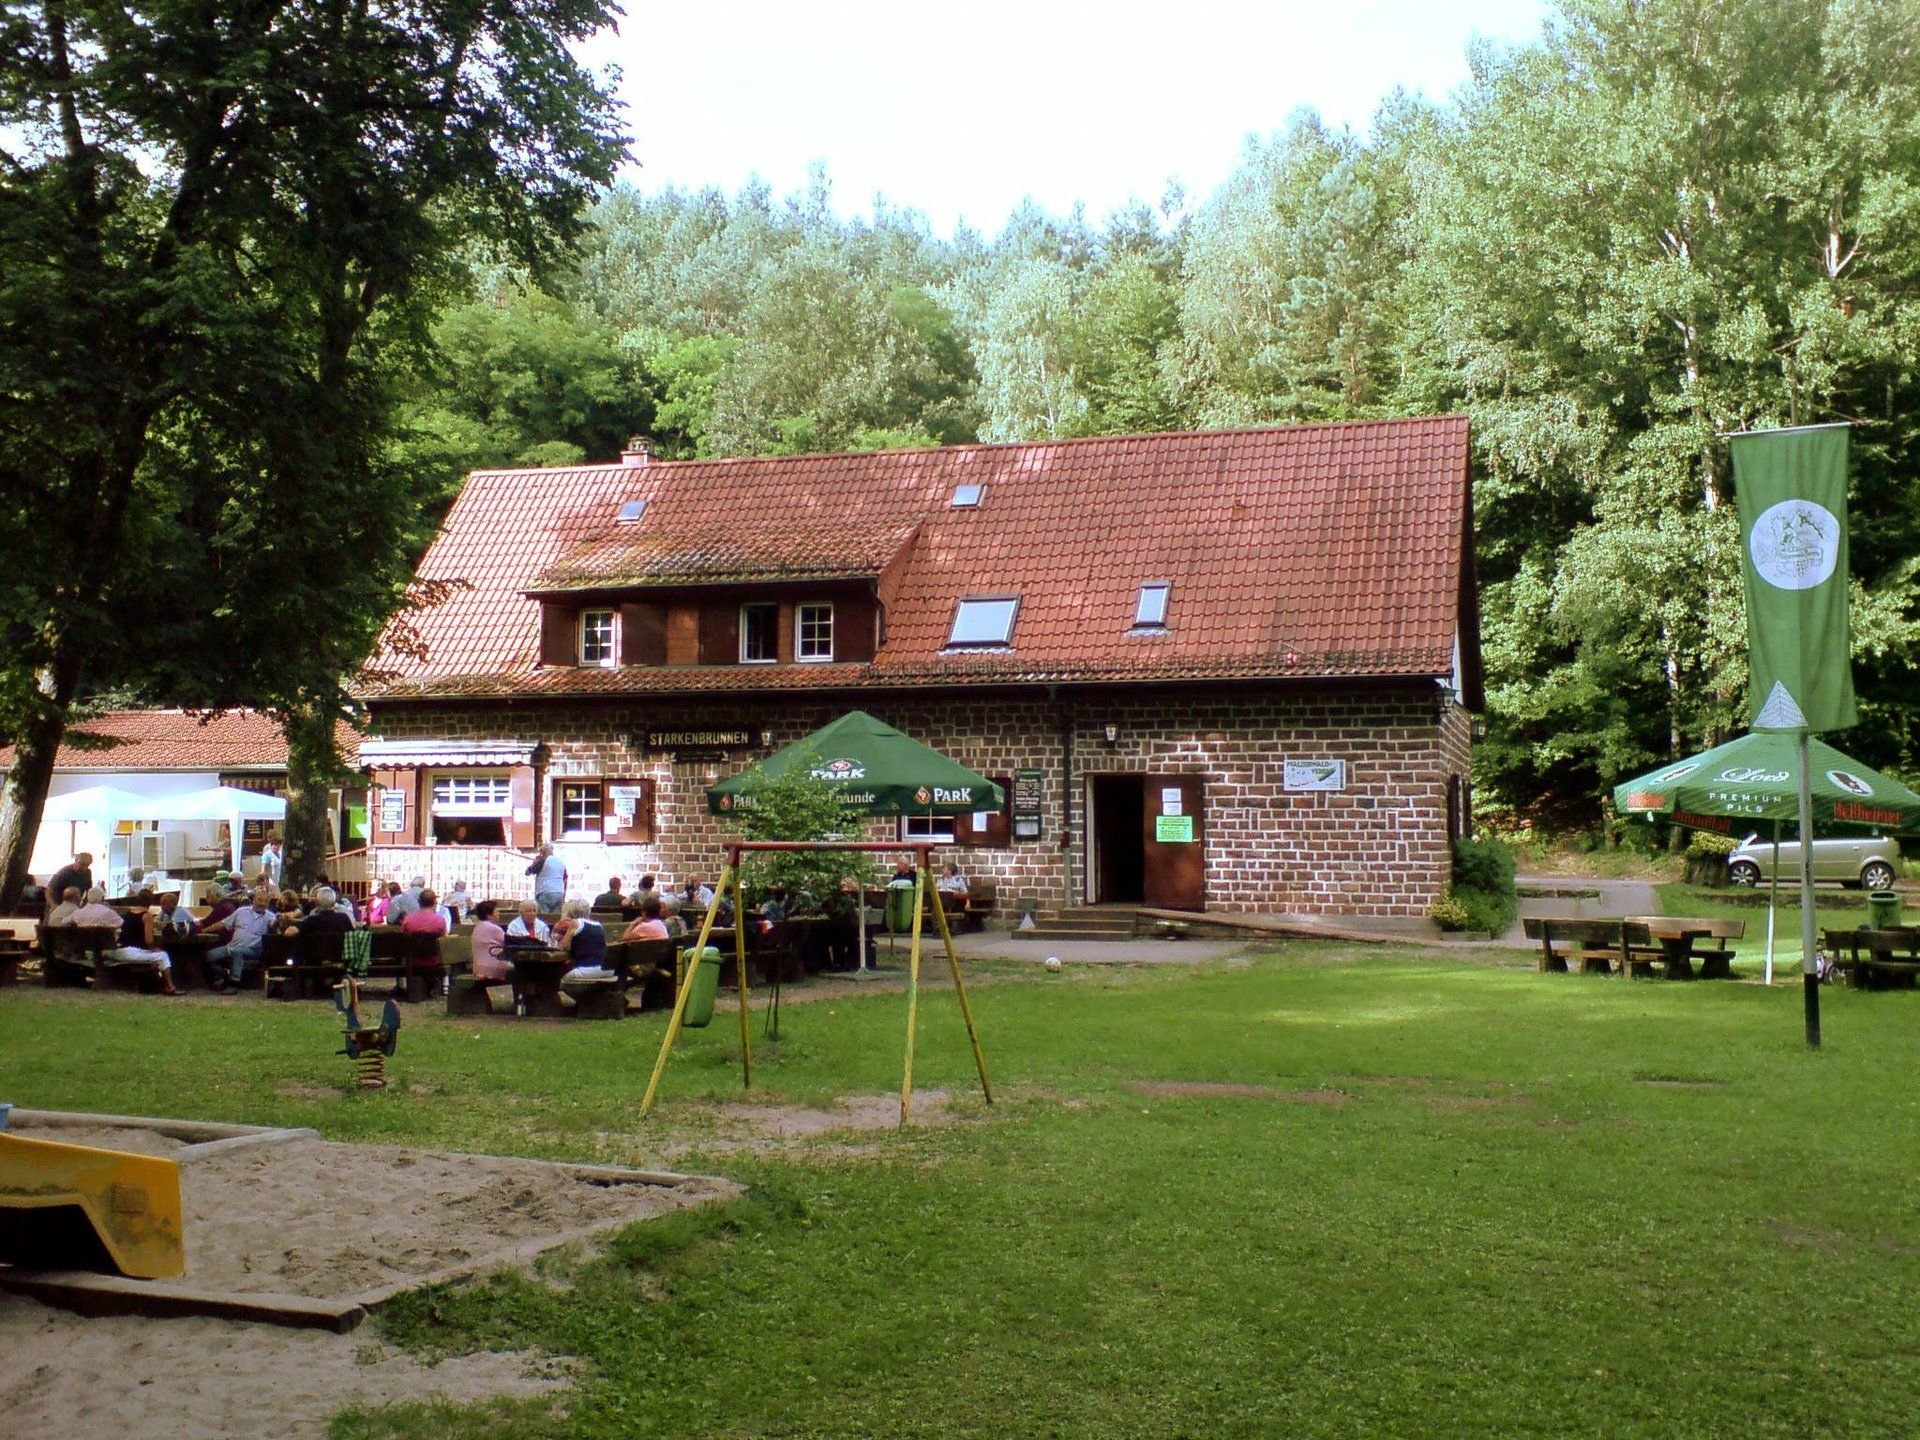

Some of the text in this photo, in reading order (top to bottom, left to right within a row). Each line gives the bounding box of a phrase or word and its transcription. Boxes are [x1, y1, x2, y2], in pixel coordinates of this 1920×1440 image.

[650, 731, 749, 746] STARKENBRUNNEN
[933, 787, 972, 802] PARK
[1709, 792, 1782, 803] PREMIUM
[1726, 803, 1763, 813] PILS
